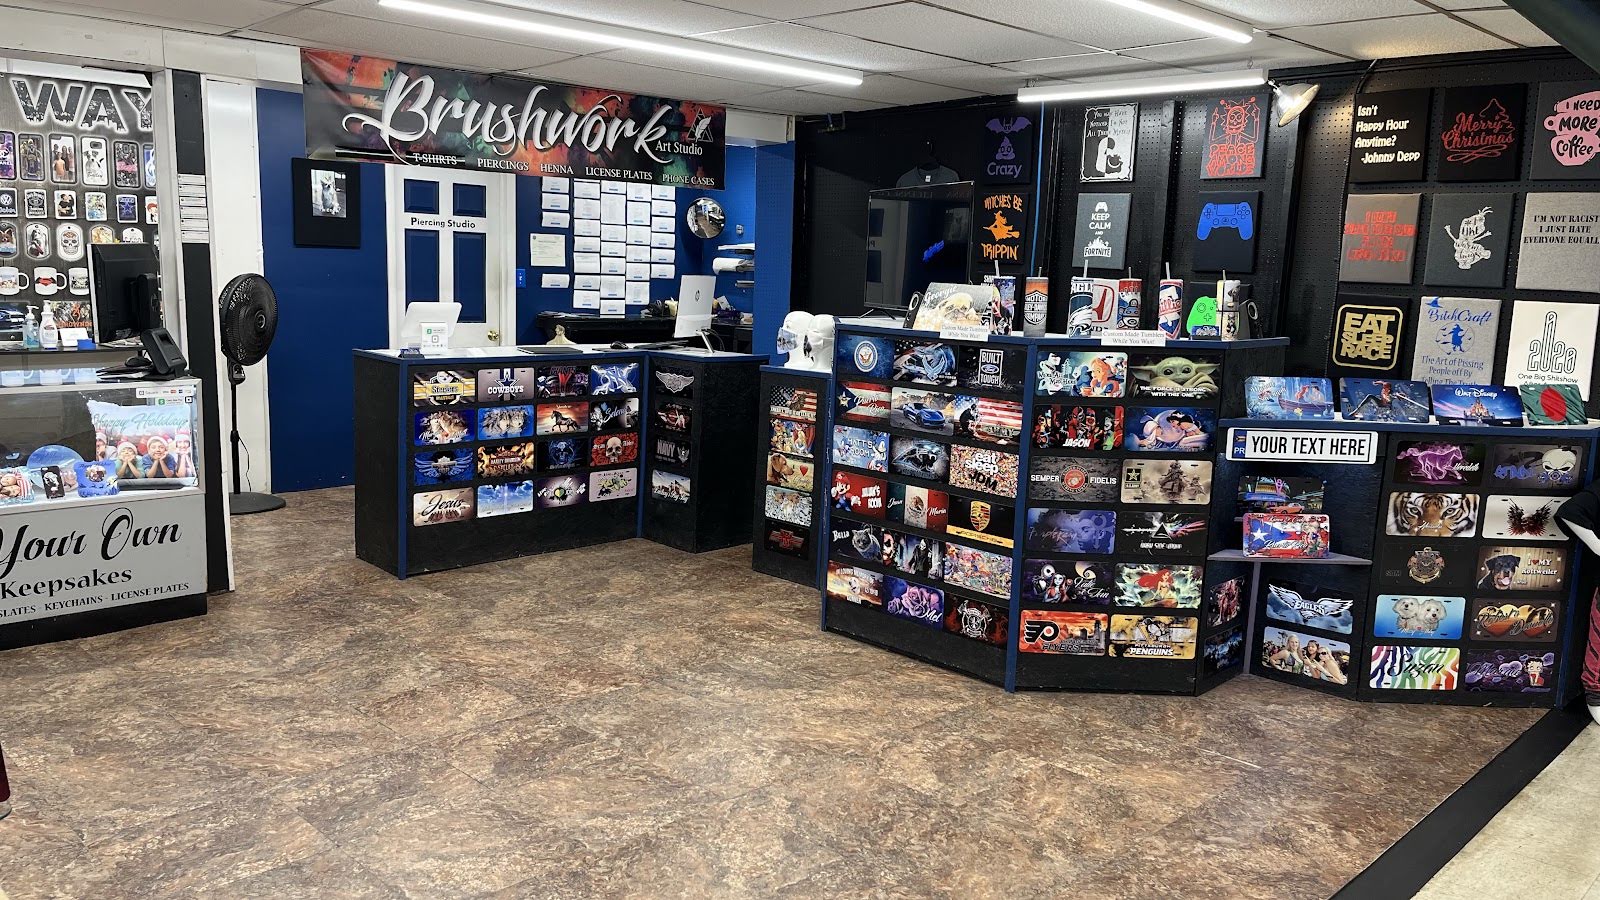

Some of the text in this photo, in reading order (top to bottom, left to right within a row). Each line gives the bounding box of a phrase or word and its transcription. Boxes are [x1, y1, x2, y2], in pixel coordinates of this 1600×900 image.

[12, 79, 152, 131] WAY
[1358, 104, 1379, 117] Isn't
[342, 72, 672, 166] Brushwork
[1355, 119, 1410, 133] Happy Hour
[1454, 111, 1503, 132] Merry
[1354, 135, 1397, 148] Anytime?
[1441, 130, 1515, 151] Christmas
[1556, 135, 1594, 159] Coffee
[655, 141, 703, 156] Art Studio
[1210, 143, 1255, 155] PEACE
[1208, 154, 1255, 166] AMONG
[1397, 151, 1420, 163] Depp
[413, 152, 715, 186] T-SHIRTS PIERCINGS HENNA LICENSE PLATES PHONE CASES
[986, 162, 1023, 179] Crazy
[1206, 163, 1255, 176] WORLDS
[984, 194, 1023, 213] WITCHES BE
[411, 217, 476, 229] Piercing Studio
[1091, 213, 1111, 221] KEEP
[1533, 215, 1547, 223] I'M
[1089, 222, 1111, 230] CALM
[1523, 236, 1600, 244] EVERYONE EQUALL
[1084, 247, 1111, 257] FORTNITE
[924, 285, 957, 304] Georgie
[1344, 313, 1395, 334] EAT
[1428, 307, 1494, 326] BitchCraft
[1343, 331, 1393, 345] SLEEP
[981, 351, 1001, 364] BUILT
[1340, 344, 1392, 360] RACE
[1422, 356, 1484, 370] The Art of Pissing
[981, 374, 1000, 384] TOUGH
[1429, 366, 1450, 375] People
[1463, 370, 1472, 378] By
[1534, 374, 1546, 382] Big
[1547, 375, 1578, 384] Shitshow
[488, 385, 523, 394] COWBOYS
[94, 413, 129, 432] Happy
[657, 439, 675, 457] NAVY
[1063, 438, 1091, 448] JASON
[1252, 436, 1366, 456] YOUR TEXT HERE
[976, 453, 996, 464] eat
[965, 458, 998, 475] sleep
[1030, 474, 1117, 485] SEMPER FIDELIS
[422, 494, 463, 516] Jesus
[0, 507, 182, 579] Your Own
[1521, 568, 1557, 576] Rottweiler
[0, 568, 132, 600] Keepsakes
[44, 595, 103, 612] KEYCHAINS
[111, 588, 151, 601] LICENSE
[154, 582, 189, 595] PLATES
[1295, 600, 1325, 614] EAGLES
[1042, 643, 1080, 651] FLYERS
[1130, 648, 1174, 656] PENGUINS
